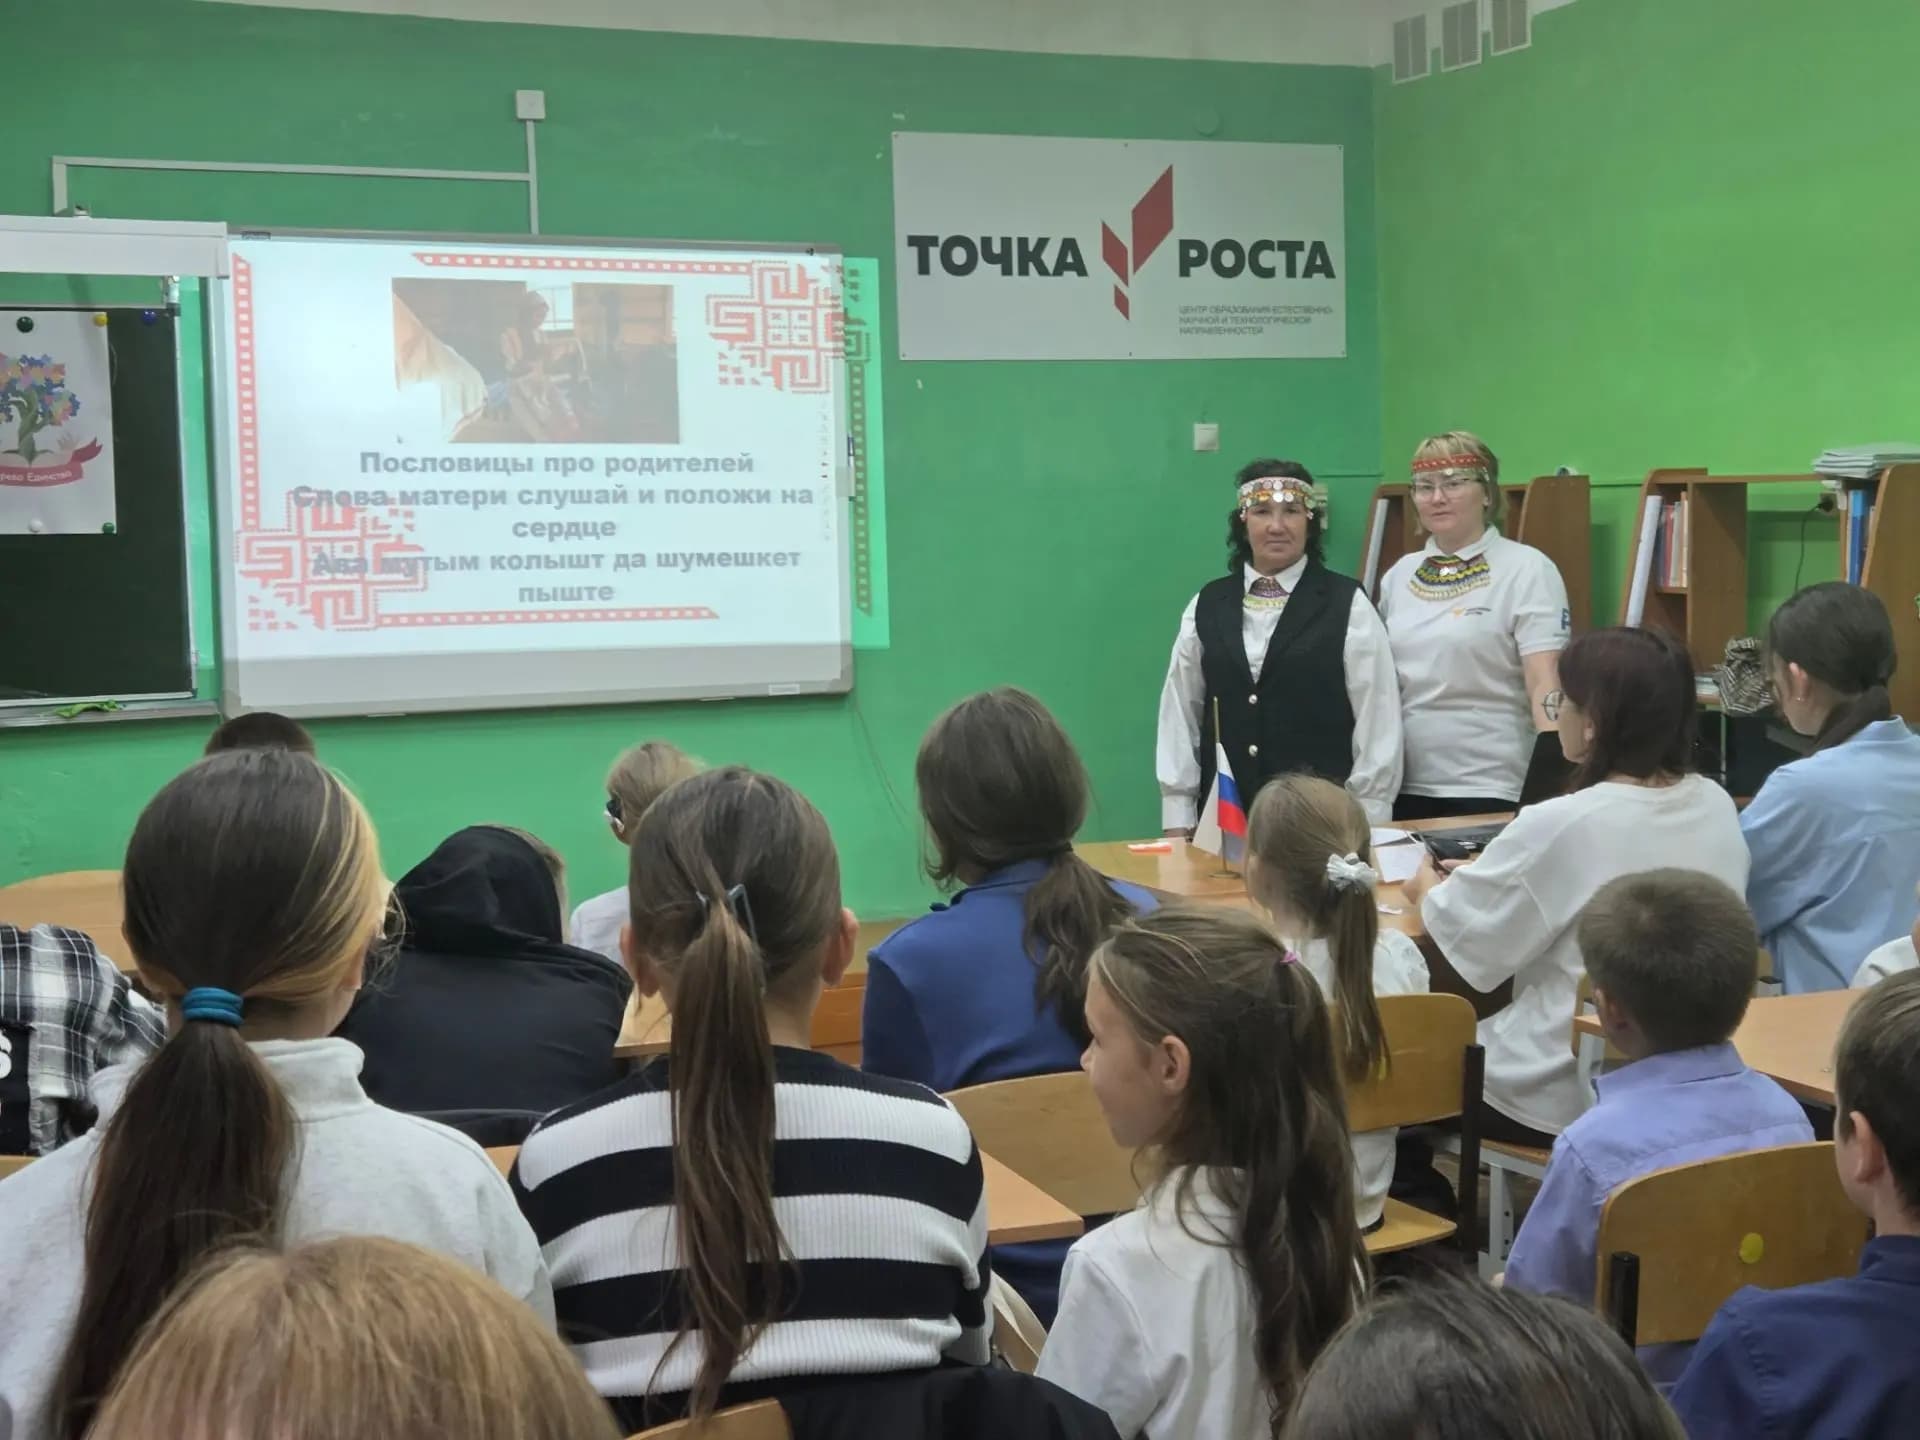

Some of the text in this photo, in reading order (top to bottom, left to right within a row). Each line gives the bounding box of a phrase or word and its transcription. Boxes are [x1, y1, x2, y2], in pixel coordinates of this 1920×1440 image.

[907, 234, 1336, 279] ТОЧКА РОСТА
[1179, 305, 1208, 315] ЦЕНТР
[1209, 305, 1271, 314] ОБРАЗОВАНИЯ
[1179, 315, 1218, 325] НАУЧНОЙ
[1221, 316, 1228, 325] И
[360, 452, 754, 477] Пословицы про родителей
[293, 484, 814, 510] Слова матери слушай и положи на
[511, 520, 617, 542] сердце
[489, 552, 605, 572] колышт
[612, 552, 647, 572] да
[656, 550, 802, 572] шумешкет
[518, 584, 615, 603] пыште
